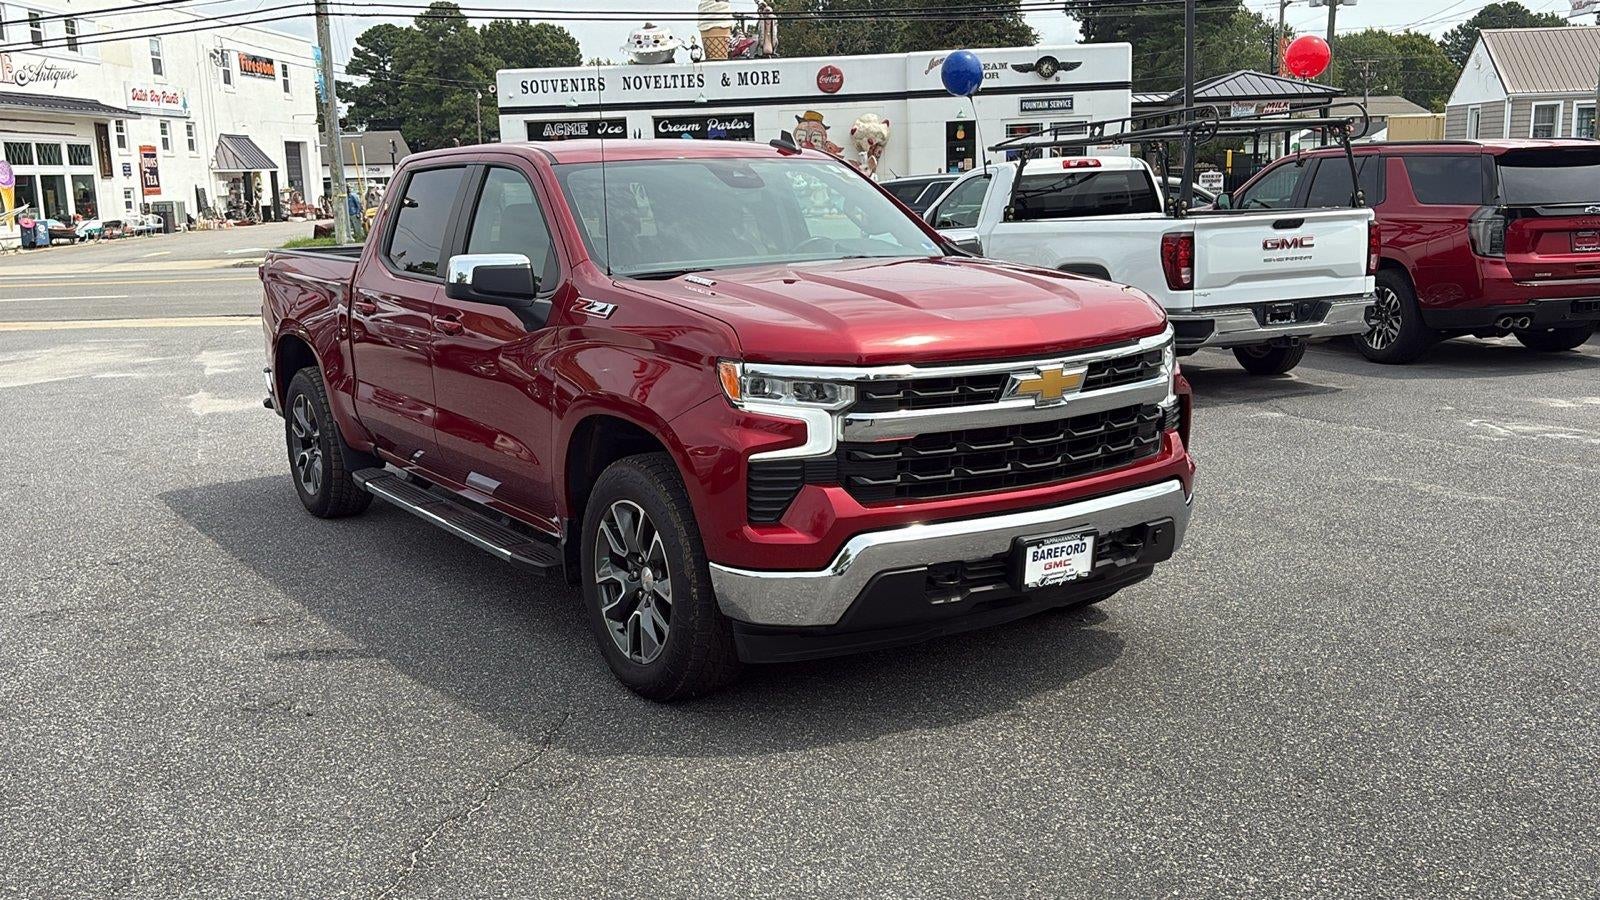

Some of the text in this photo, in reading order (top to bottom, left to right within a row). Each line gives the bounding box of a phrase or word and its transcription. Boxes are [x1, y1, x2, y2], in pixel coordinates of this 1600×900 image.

[239, 52, 275, 75] Firestone
[15, 58, 78, 88] Antiques
[520, 70, 780, 94] SOUVENIRS NOVELTIES & MORE
[131, 87, 179, 106] Dutch Boy Paints
[1022, 99, 1072, 110] FOUNTAIN SERVICE
[1266, 101, 1289, 109] MILK
[542, 121, 624, 136] ACME Ice
[658, 118, 751, 133] Cream Parlor
[145, 174, 159, 186] TEA
[1262, 236, 1315, 251] GMC
[1032, 542, 1086, 562] BAREFORD
[1043, 558, 1073, 571] GMC
